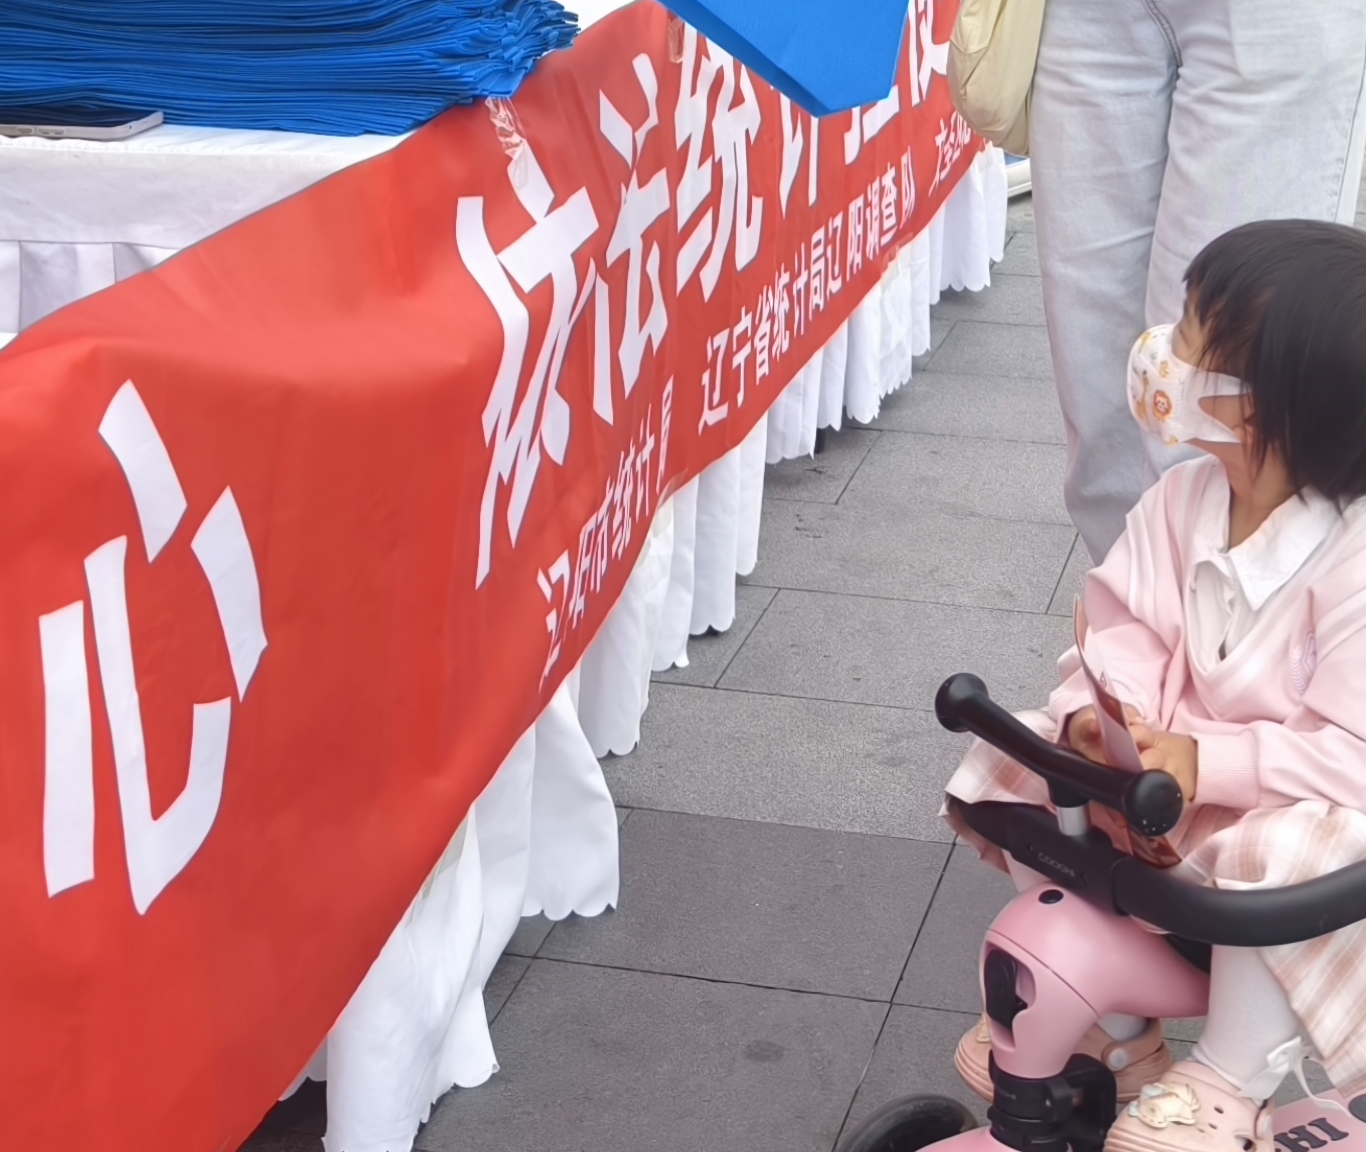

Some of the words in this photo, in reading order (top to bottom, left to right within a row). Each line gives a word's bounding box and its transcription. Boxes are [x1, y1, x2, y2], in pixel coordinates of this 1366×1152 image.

[535, 375, 675, 678] 辽阳市统计局
[698, 152, 916, 437] 辽宁省统计局辽阳调查队
